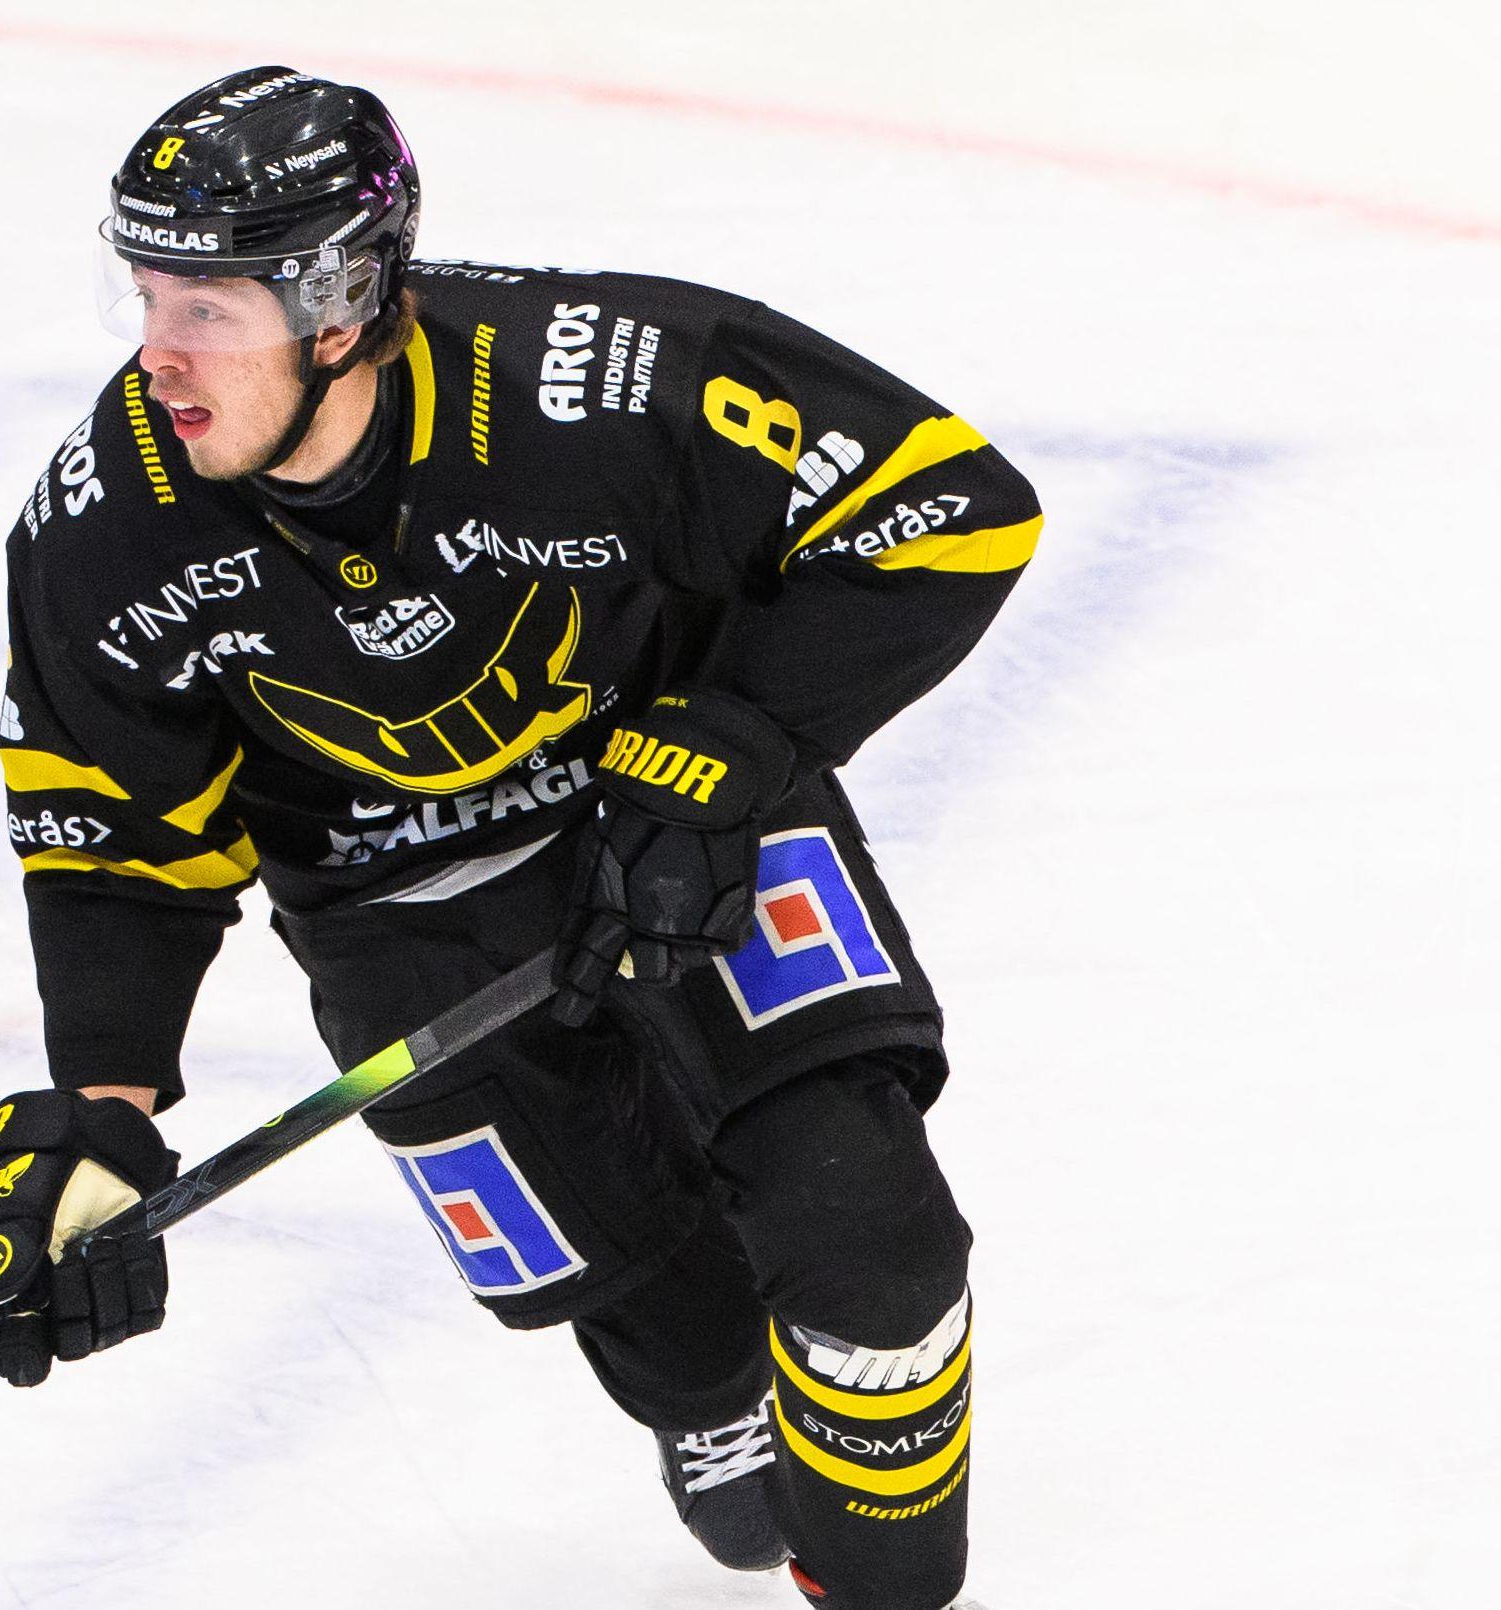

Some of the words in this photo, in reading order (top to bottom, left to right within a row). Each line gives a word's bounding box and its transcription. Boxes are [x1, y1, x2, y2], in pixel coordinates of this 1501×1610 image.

[152, 136, 186, 171] 8
[284, 139, 348, 173] Newsafe
[119, 194, 177, 218] WARRIOR
[470, 323, 497, 466] WARRIOR
[538, 303, 601, 422] AROS
[601, 317, 636, 410] INDUSTRI
[628, 325, 662, 414] PARTNER
[57, 401, 105, 516] ROS
[124, 372, 176, 504] WARRIOR
[703, 376, 802, 476] 8
[786, 430, 865, 527] ABB
